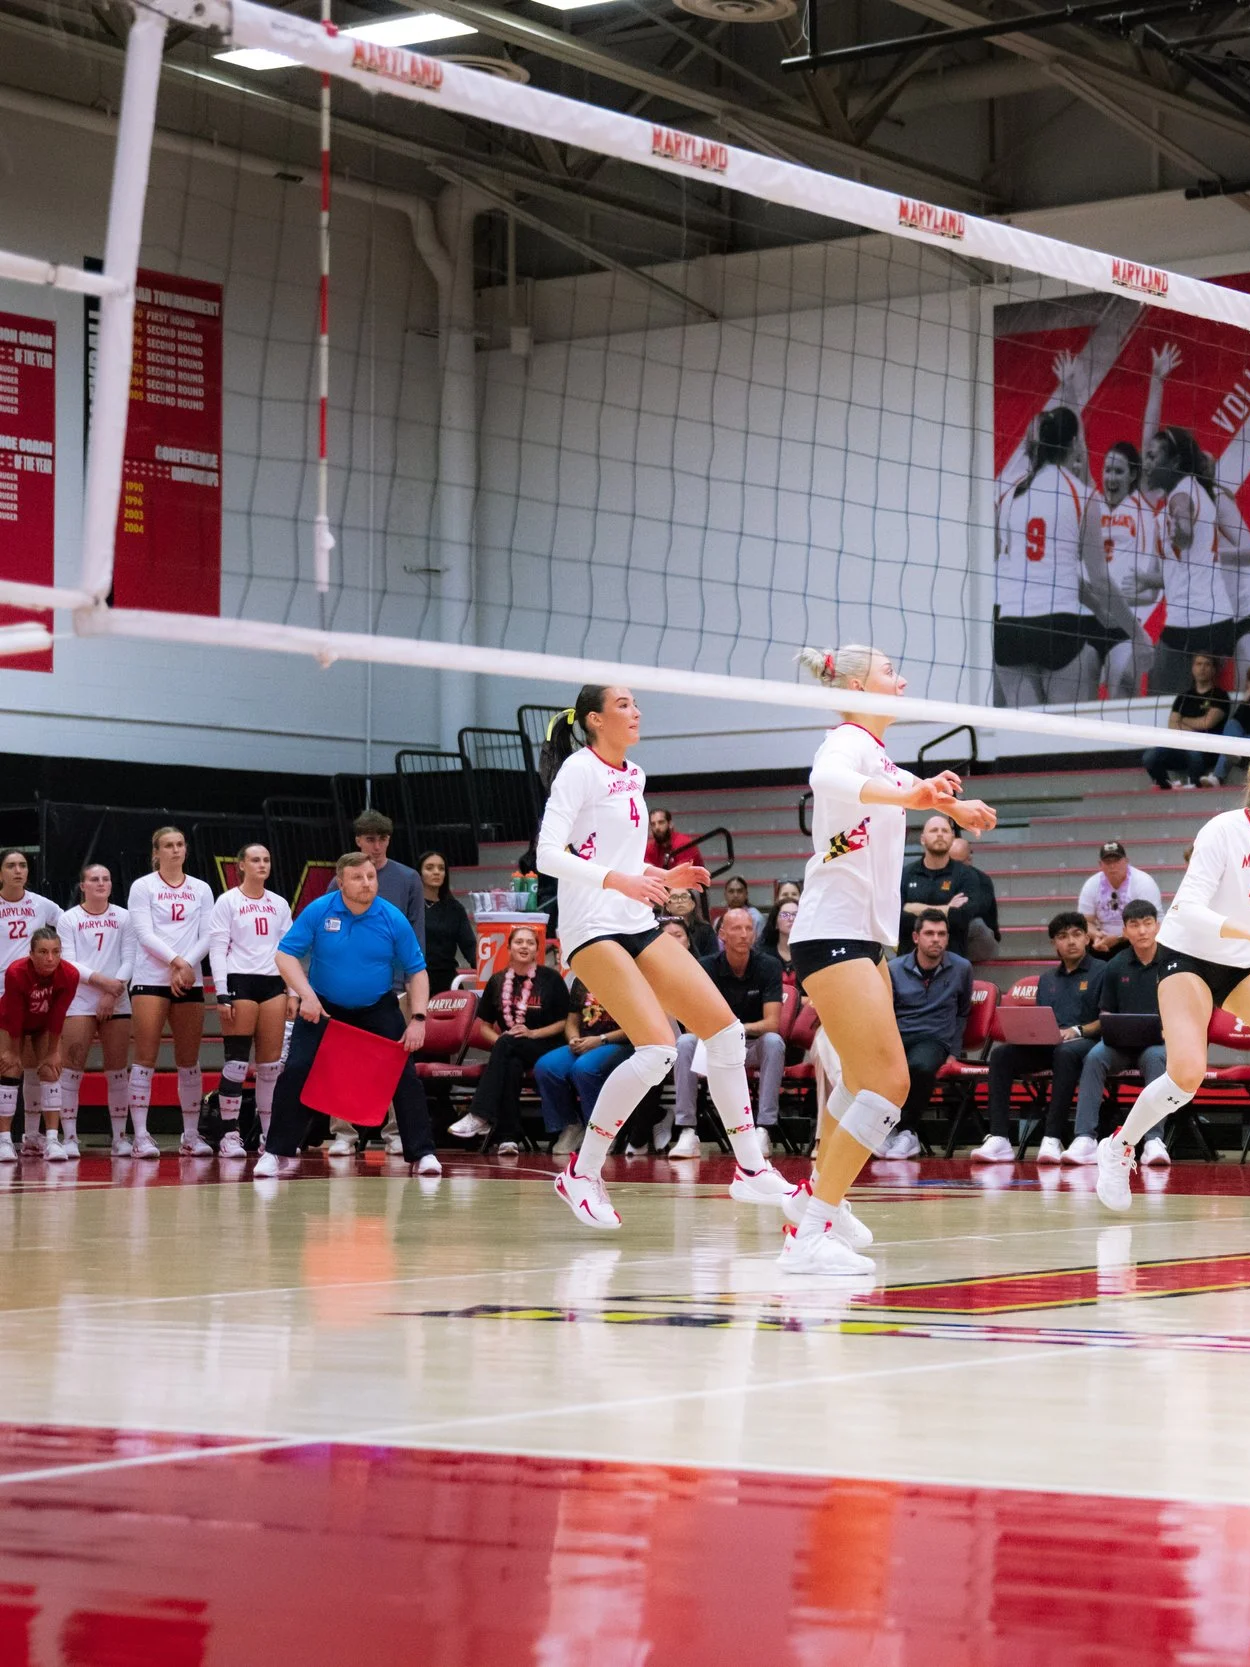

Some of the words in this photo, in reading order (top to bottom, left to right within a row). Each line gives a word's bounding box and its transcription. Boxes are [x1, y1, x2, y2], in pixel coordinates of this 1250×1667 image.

[353, 39, 443, 87] MARYLAND
[653, 127, 728, 169] MARYLAND
[900, 199, 965, 235] MARYLAND
[1112, 258, 1168, 292] MARYLAND
[1025, 517, 1047, 562] 9
[630, 798, 640, 828] 4
[158, 892, 196, 902] MARYLAND
[171, 903, 185, 921] 12
[239, 903, 277, 917] MARYLAND
[8, 920, 28, 939] 22
[78, 920, 120, 931] MARYLAND
[254, 917, 269, 936] 10
[95, 933, 104, 951] 7
[479, 937, 491, 960] G
[427, 998, 468, 1010] MARYLAND
